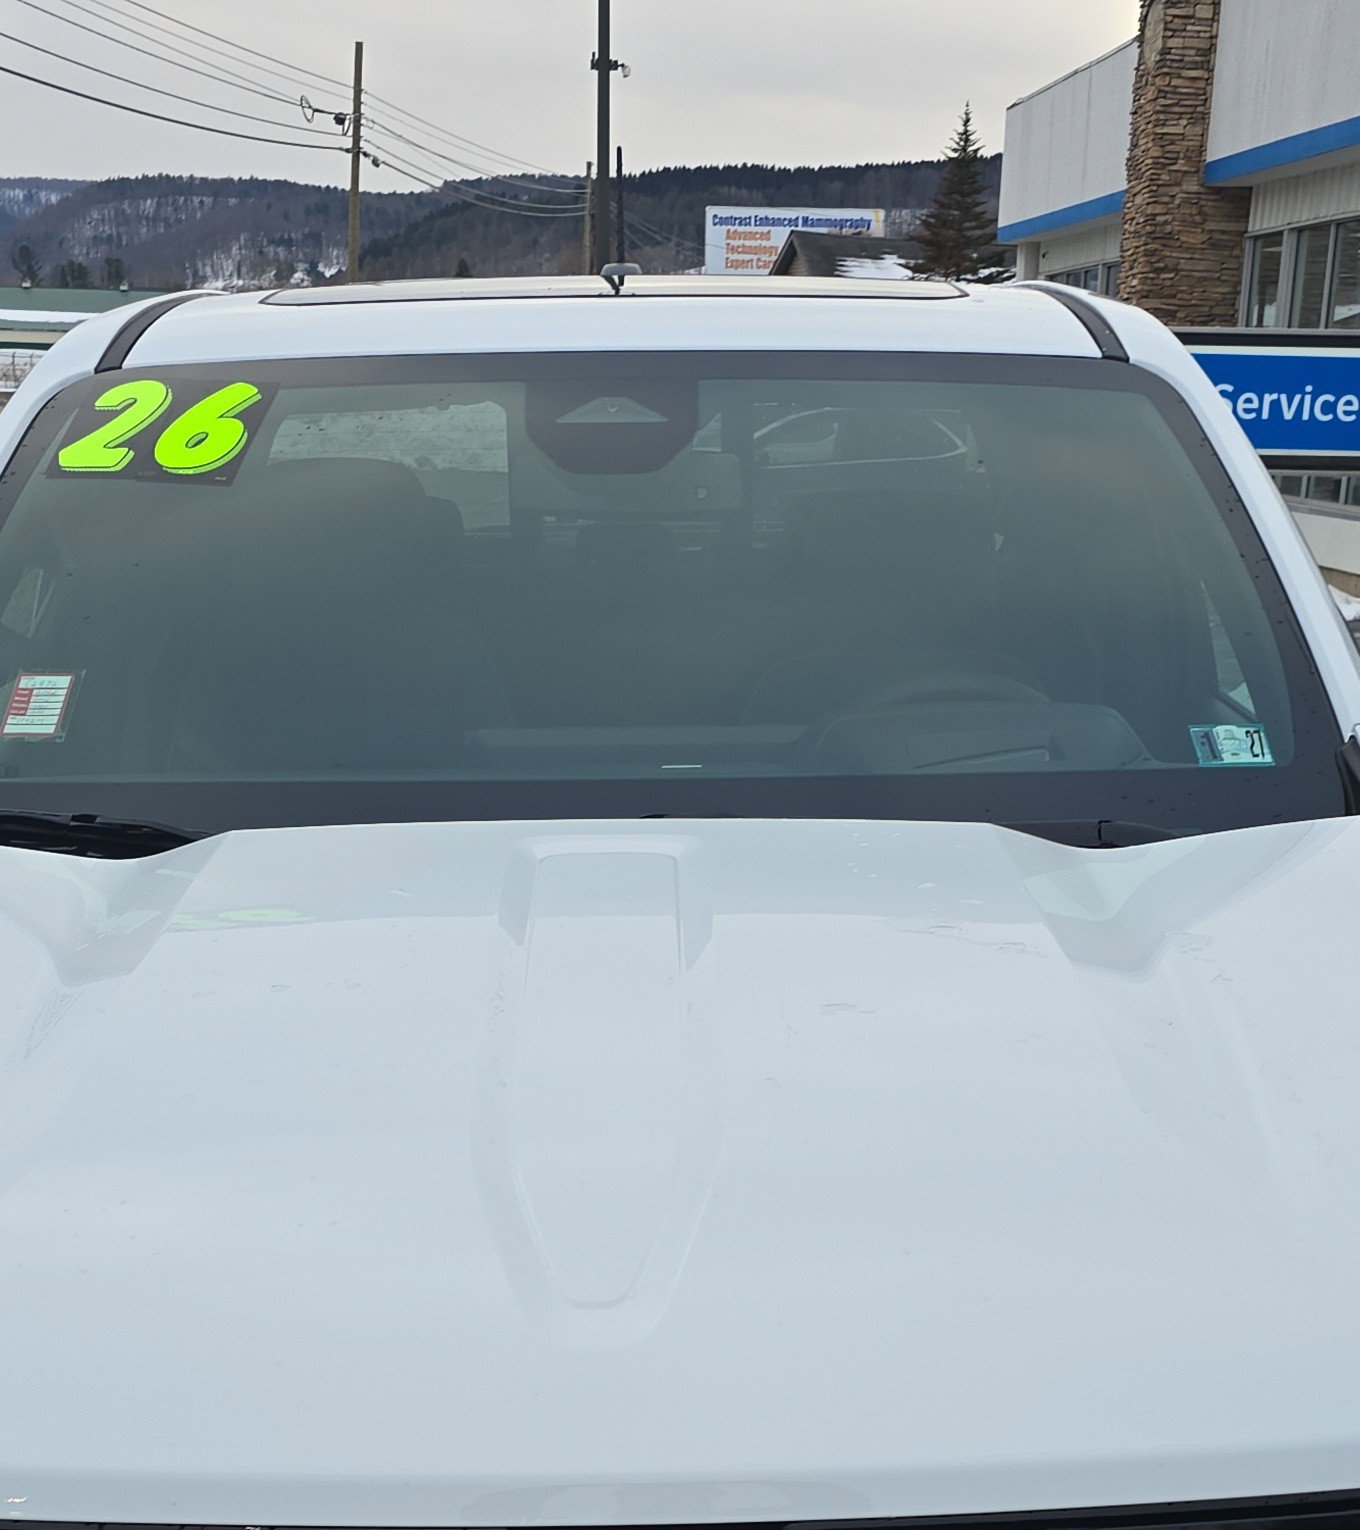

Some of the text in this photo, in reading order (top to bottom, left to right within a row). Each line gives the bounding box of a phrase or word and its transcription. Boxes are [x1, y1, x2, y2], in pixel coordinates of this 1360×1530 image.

[712, 213, 752, 227] Contrast
[754, 214, 799, 228] Enhanced
[801, 216, 872, 230] Mammography
[725, 228, 771, 241] Advanced
[725, 242, 779, 256] Technology
[725, 257, 775, 270] Expert Car
[1215, 383, 1360, 422] Service
[58, 379, 262, 475] 26
